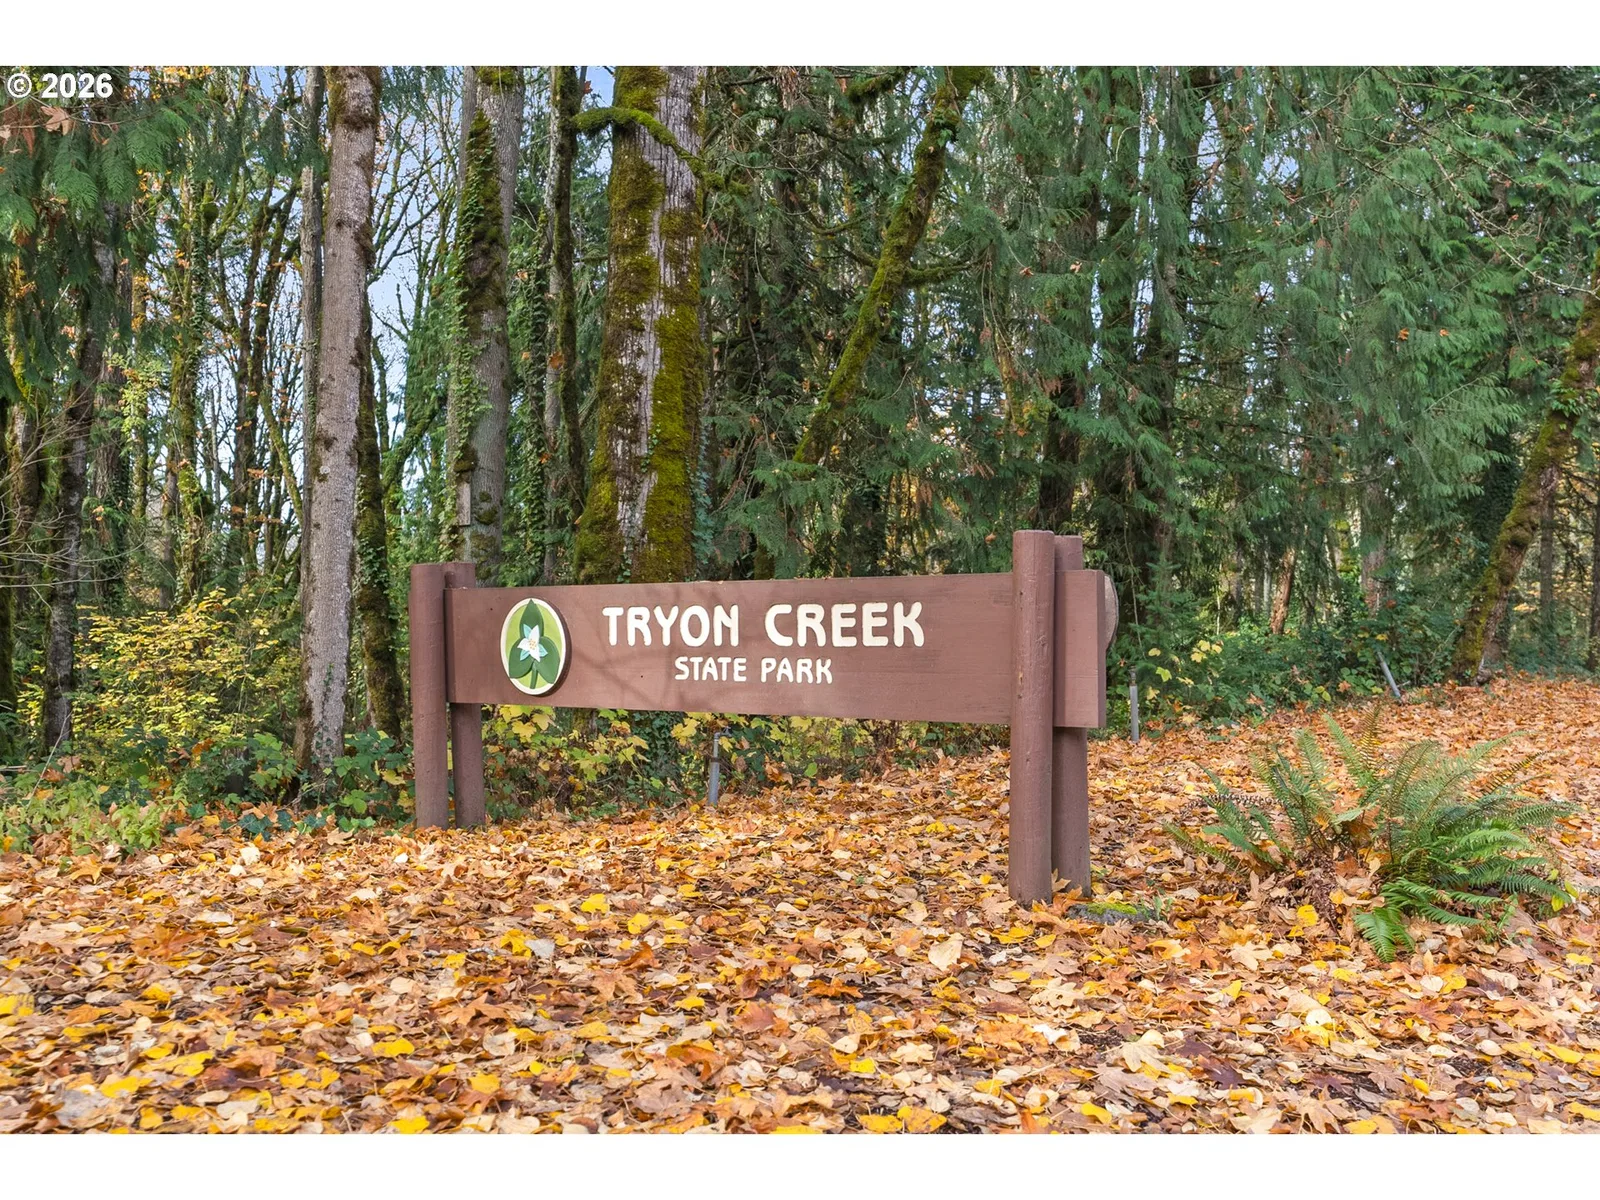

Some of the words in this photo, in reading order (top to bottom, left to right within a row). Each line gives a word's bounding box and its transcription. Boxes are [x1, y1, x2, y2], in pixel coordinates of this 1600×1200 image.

[602, 605, 739, 646] TRYON
[765, 602, 925, 647] CREEK
[674, 656, 747, 682] STATE
[760, 657, 833, 684] PARK
